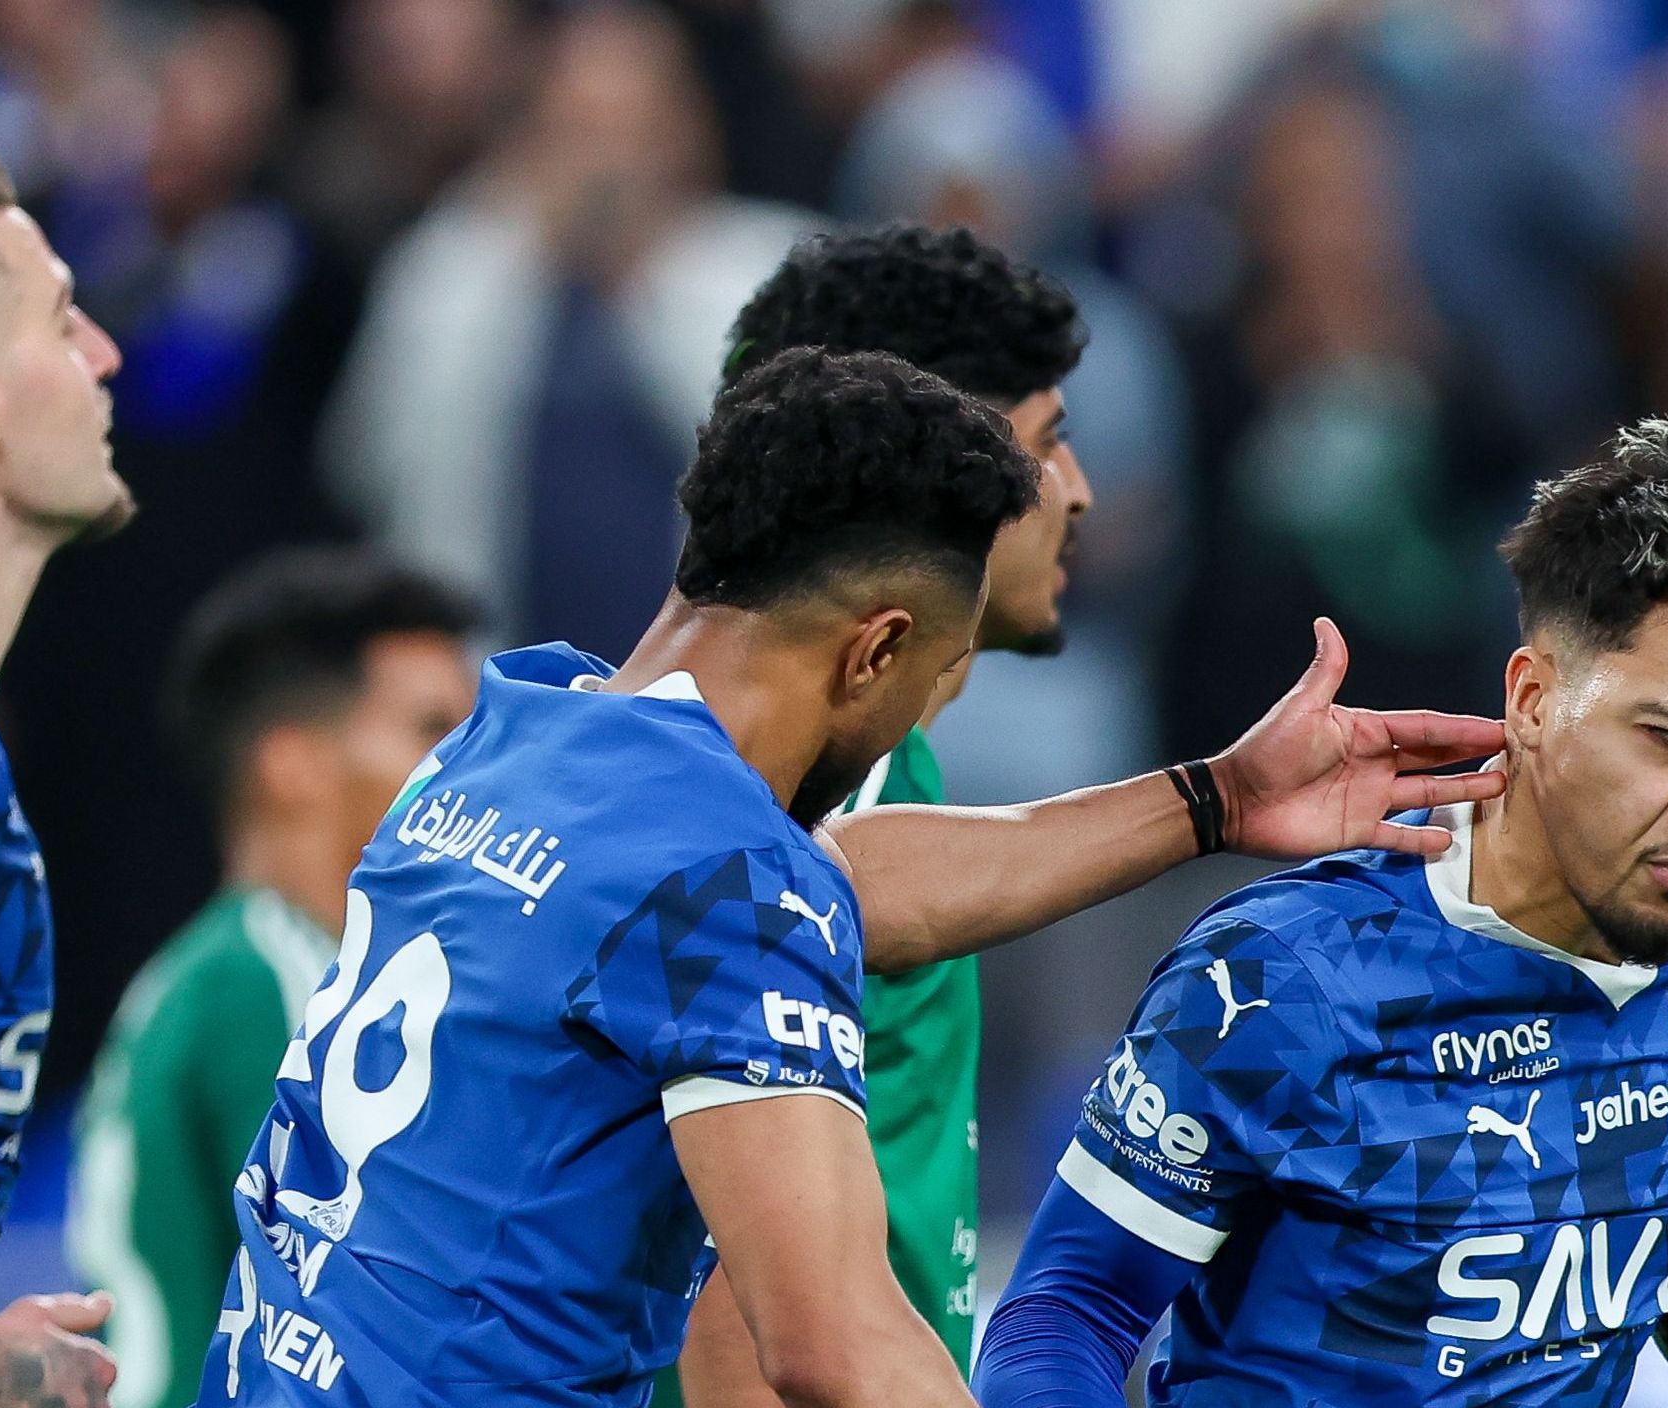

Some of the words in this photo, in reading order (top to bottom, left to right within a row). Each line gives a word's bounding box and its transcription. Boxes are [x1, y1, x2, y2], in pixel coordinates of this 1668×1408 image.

[396, 789, 501, 864] الرياض
[471, 827, 568, 917] بنك
[762, 990, 865, 1083] tre
[1432, 1018, 1551, 1077] flynas
[1107, 1035, 1209, 1165] tree
